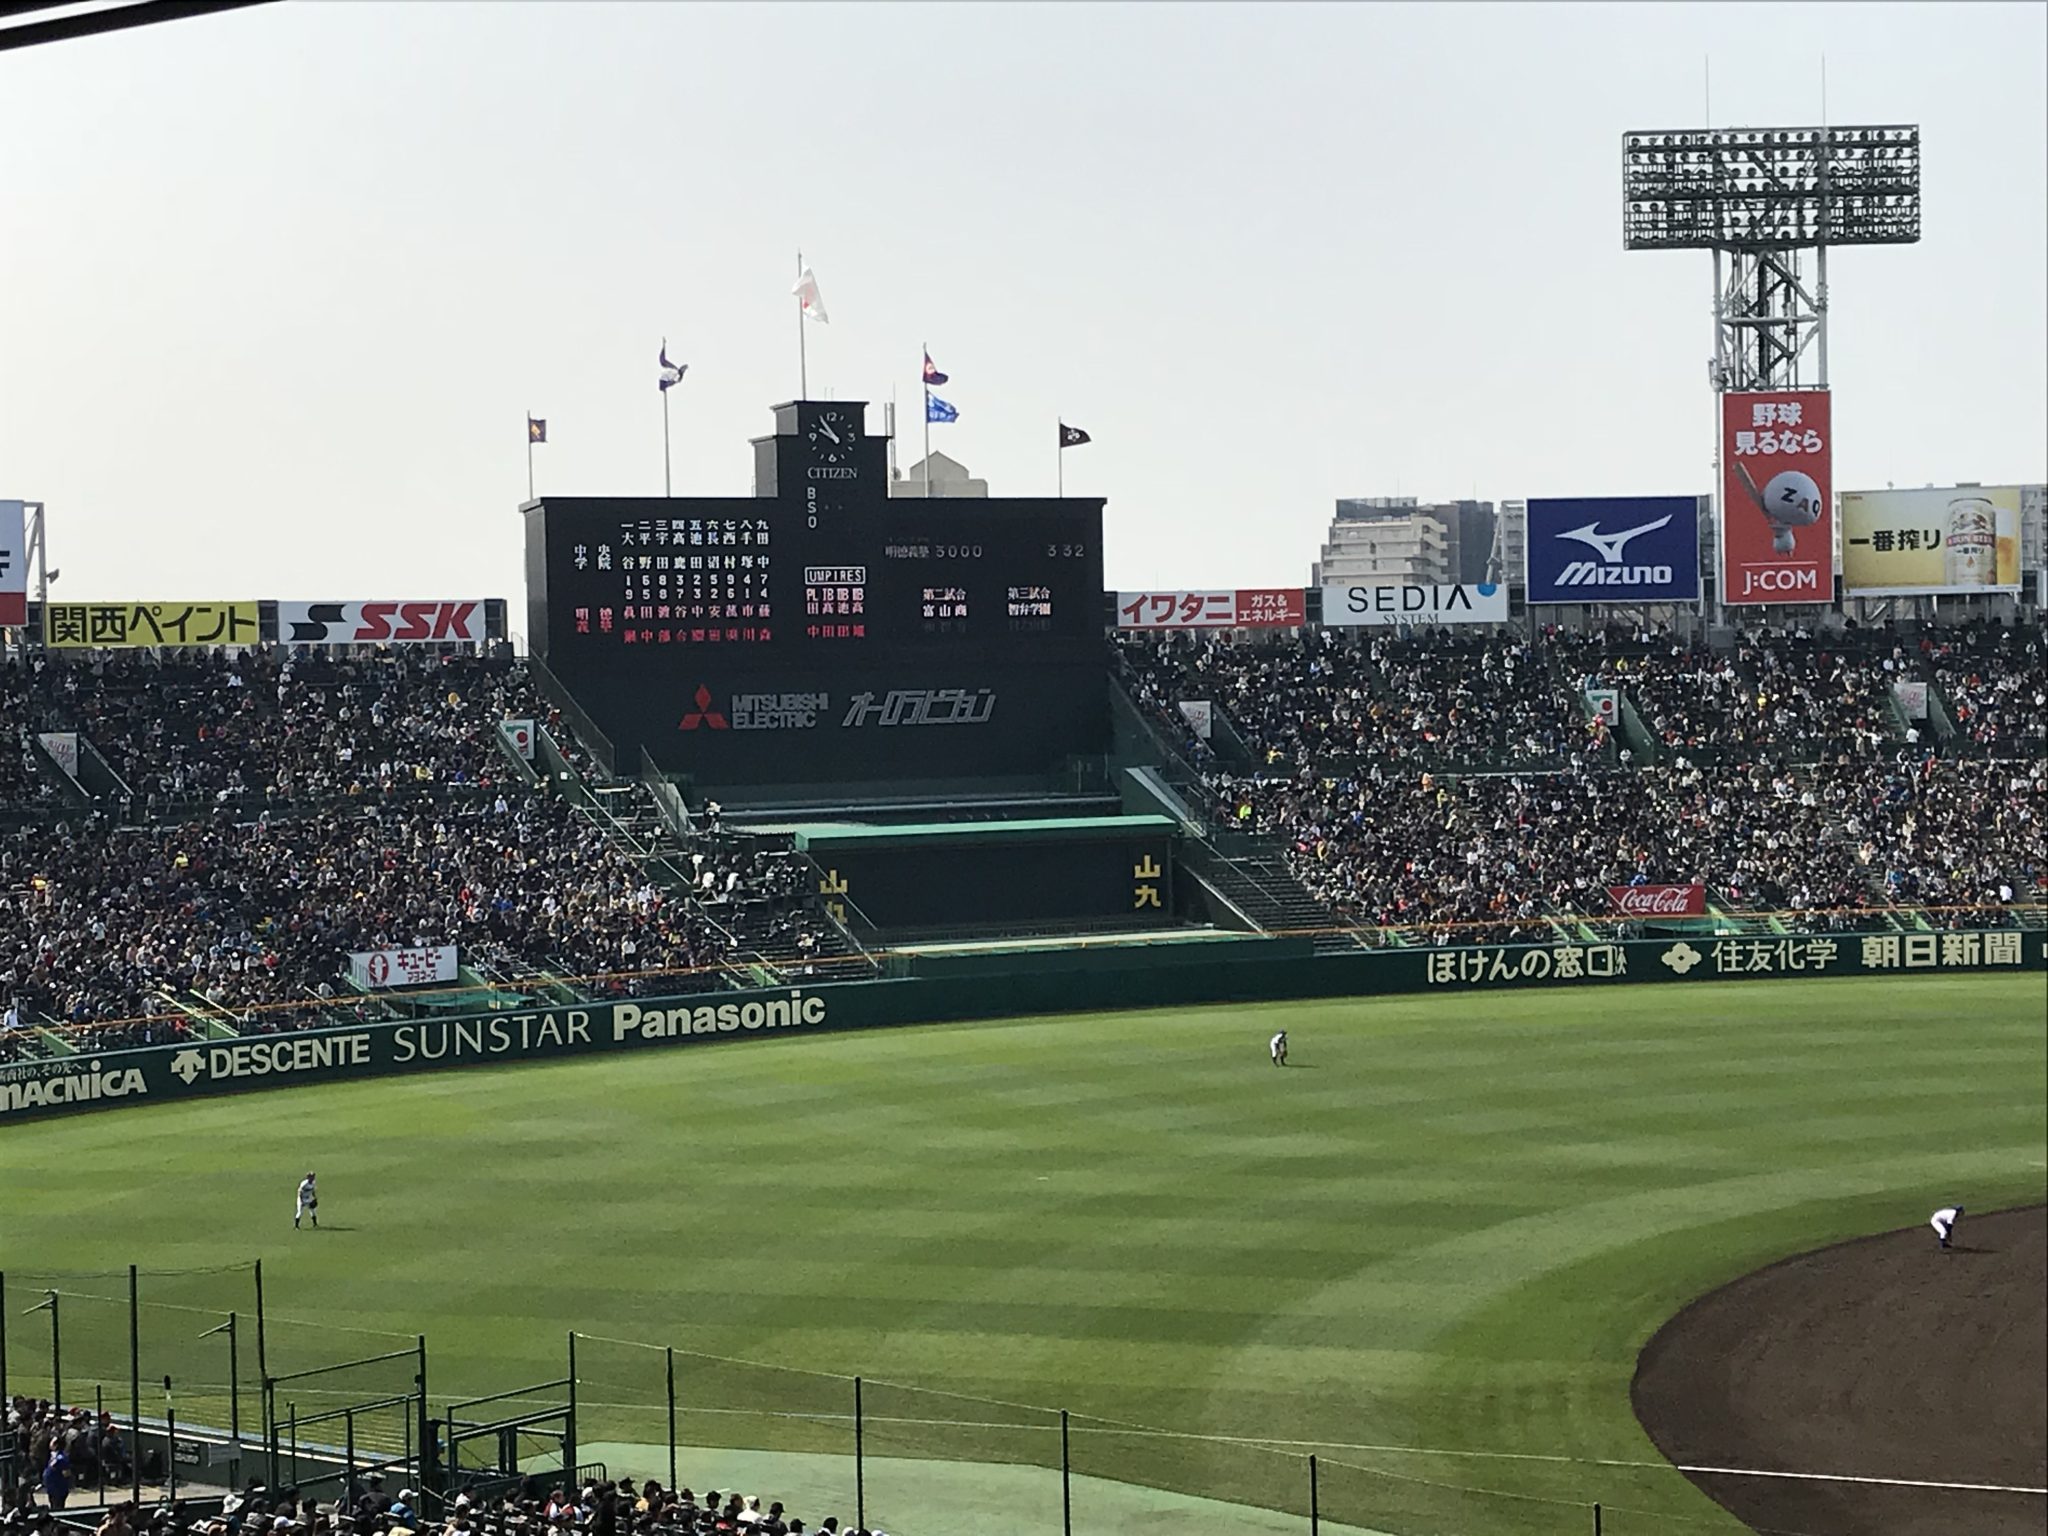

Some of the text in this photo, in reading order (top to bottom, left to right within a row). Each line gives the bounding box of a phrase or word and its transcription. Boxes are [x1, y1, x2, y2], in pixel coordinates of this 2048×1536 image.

[826, 412, 837, 421] 12
[1752, 403, 1802, 427] 野球
[809, 433, 817, 442] 9
[848, 433, 856, 442] 3
[1734, 430, 1823, 456] 見るなら
[828, 453, 837, 462] 6
[807, 466, 858, 479] CITIZEN
[807, 487, 816, 499] B
[807, 502, 817, 513] S
[1849, 528, 1941, 552] 一番搾り
[809, 570, 861, 582] UMPIRES
[1554, 562, 1672, 586] MIZUNO
[1742, 570, 1817, 595] J:COM
[1122, 594, 1232, 624] イワタニ
[1348, 585, 1472, 613] SEDIA
[50, 605, 256, 643] 関西ペイント
[353, 603, 477, 640] SSK
[1239, 609, 1301, 623] エネルギー
[1383, 612, 1439, 625] SYSTEM
[732, 693, 829, 711] MITSUBISHI
[732, 711, 816, 729] ELECTRIC
[1711, 939, 1837, 973] 住友化学
[1861, 933, 2022, 967] 朝日新聞
[613, 990, 826, 1040] Panasonic
[393, 1011, 591, 1062] SUNSTAR
[210, 1034, 370, 1079] DESCENTE
